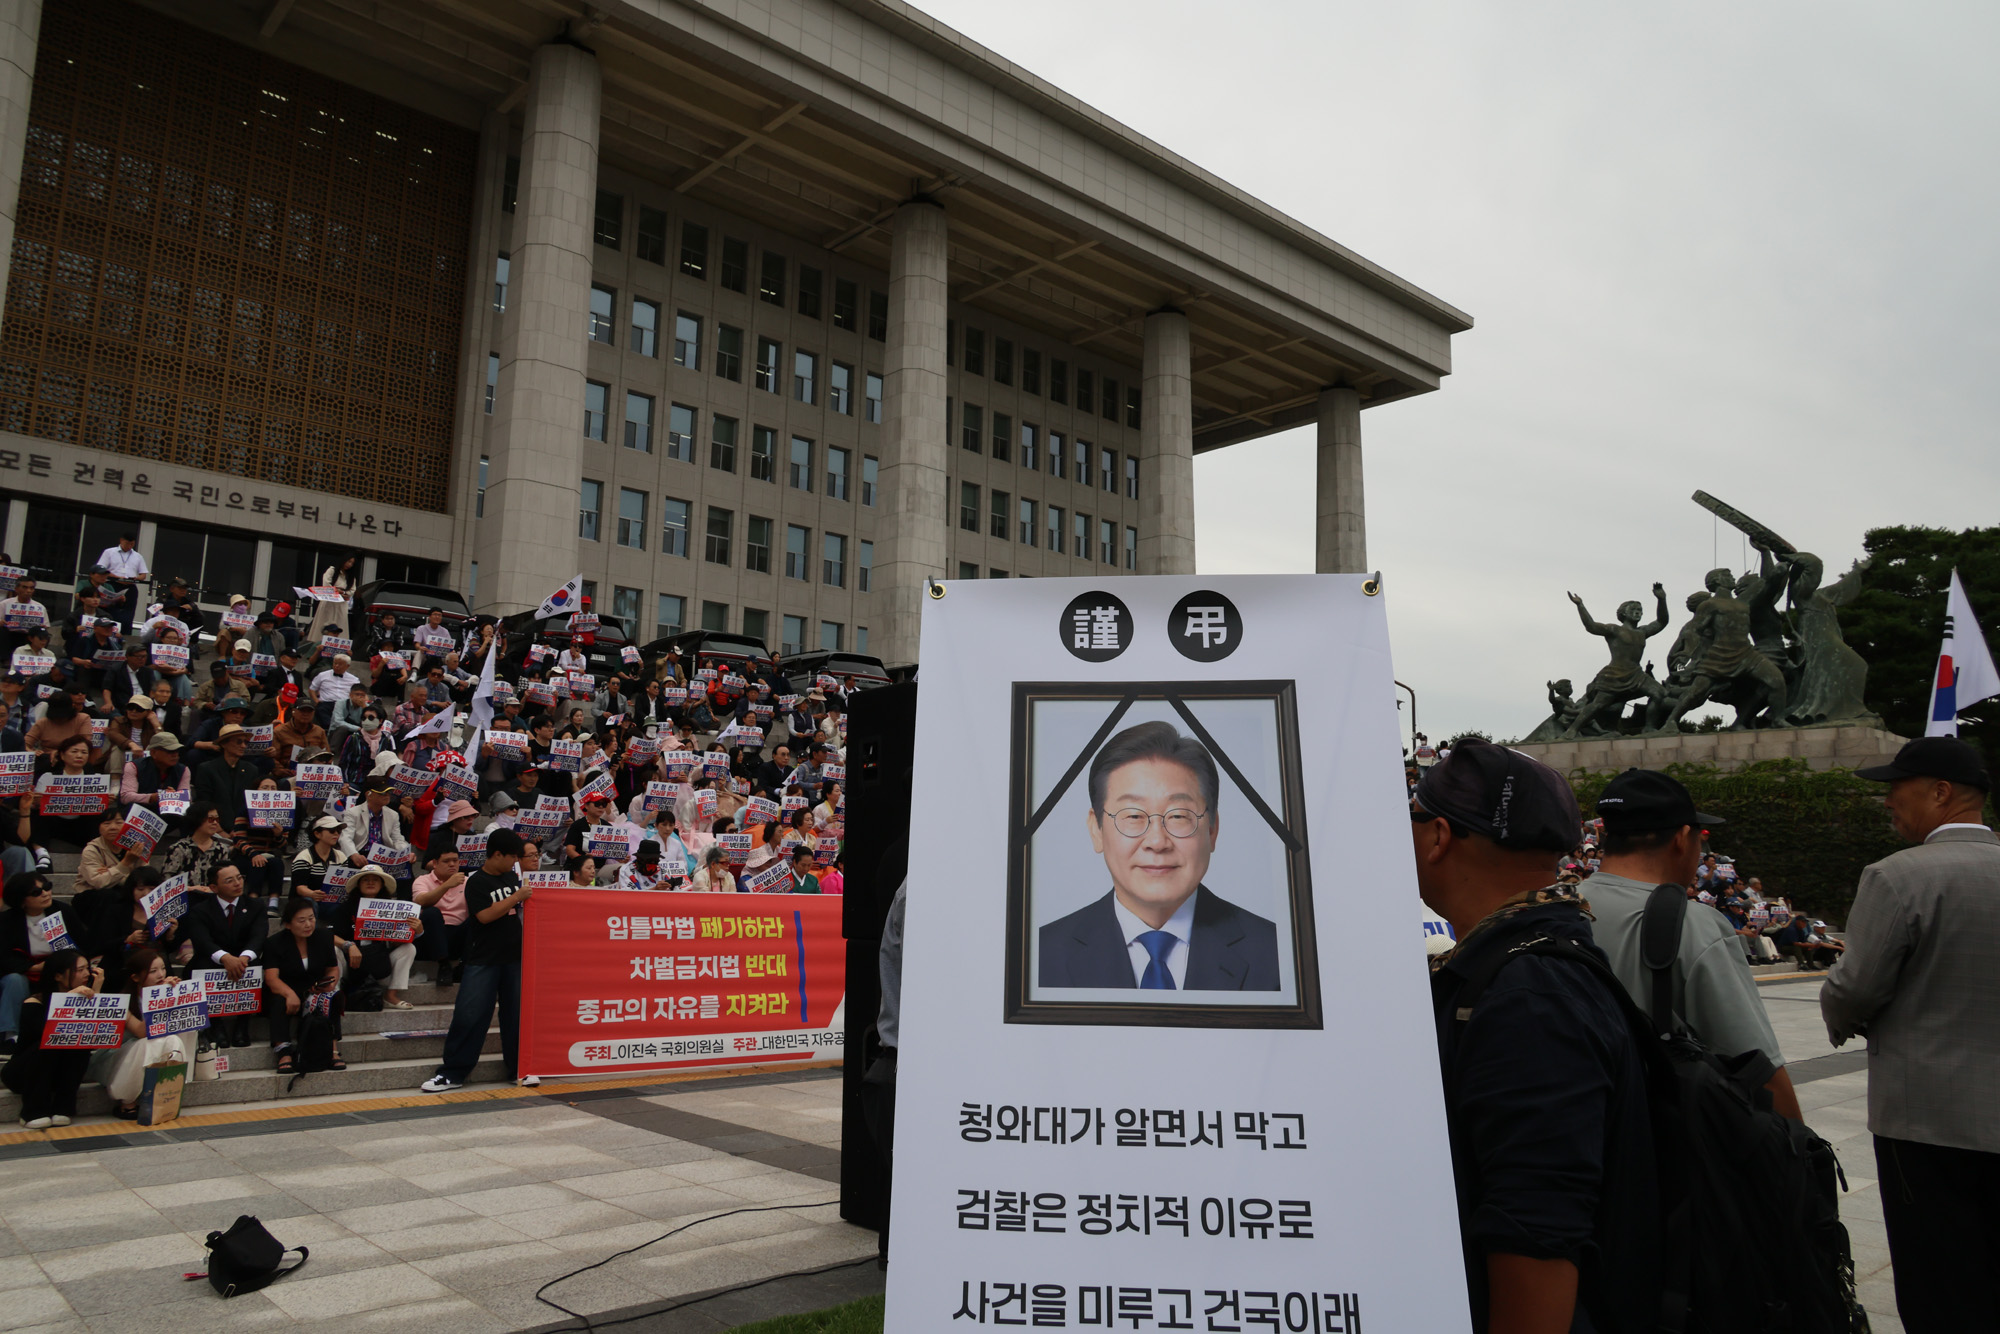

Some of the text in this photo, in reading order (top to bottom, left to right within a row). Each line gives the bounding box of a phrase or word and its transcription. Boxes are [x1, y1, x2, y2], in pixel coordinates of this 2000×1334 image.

[0, 450, 402, 537] 모든 권력은 국민으로부터 나온다
[1074, 606, 1227, 649] 謹 弔
[489, 737, 508, 745] 진실을
[490, 731, 525, 741] 부정선거
[555, 741, 580, 750] 부정선거
[53, 777, 101, 785] 피하지 말고
[302, 773, 325, 781] 진실을
[82, 785, 108, 793] 받아라
[49, 796, 102, 804] 국민합의 없는
[43, 804, 105, 813] 개헌은 반대한다
[269, 810, 290, 818] 유공자
[139, 810, 155, 825] 피하지
[520, 816, 540, 824] 진실을
[523, 811, 560, 819] 부정선거
[253, 818, 267, 826] 전면
[597, 826, 628, 836] 부정선거
[529, 873, 566, 881] 부정선거
[368, 901, 413, 911] 피하지 말고
[360, 909, 377, 917] 재판
[378, 910, 394, 918] 부터
[363, 921, 395, 930] 국민합의
[607, 916, 784, 940] 입틀막법 폐기하라
[358, 929, 411, 940] 개헌은 반대한다
[630, 954, 787, 980] 차별금지법 반대
[150, 981, 200, 998] 부정선거
[216, 980, 261, 991] 부터 받아라
[63, 996, 120, 1008] 피하지 말고
[147, 992, 202, 1011] 진실을 밝혀라
[207, 992, 255, 1003] 민합의 없는
[224, 1000, 259, 1013] 반대한다
[577, 993, 790, 1024] 종교의 자유를 지켜라
[52, 1008, 126, 1019] 재판 부터 받아라
[152, 1006, 199, 1024] 518 유공자
[55, 1023, 118, 1034] 국민합의 없는
[149, 1016, 207, 1037] 전면 공개하라
[46, 1034, 120, 1046] 개헌은 반대한다
[661, 1039, 724, 1055] 국회의원실
[960, 1103, 1305, 1150] 청와대가 알면서 막고
[957, 1190, 1313, 1239] 검찰은 정치적 이유로
[953, 1282, 1361, 1334] 사건을 미루고 건국이래
